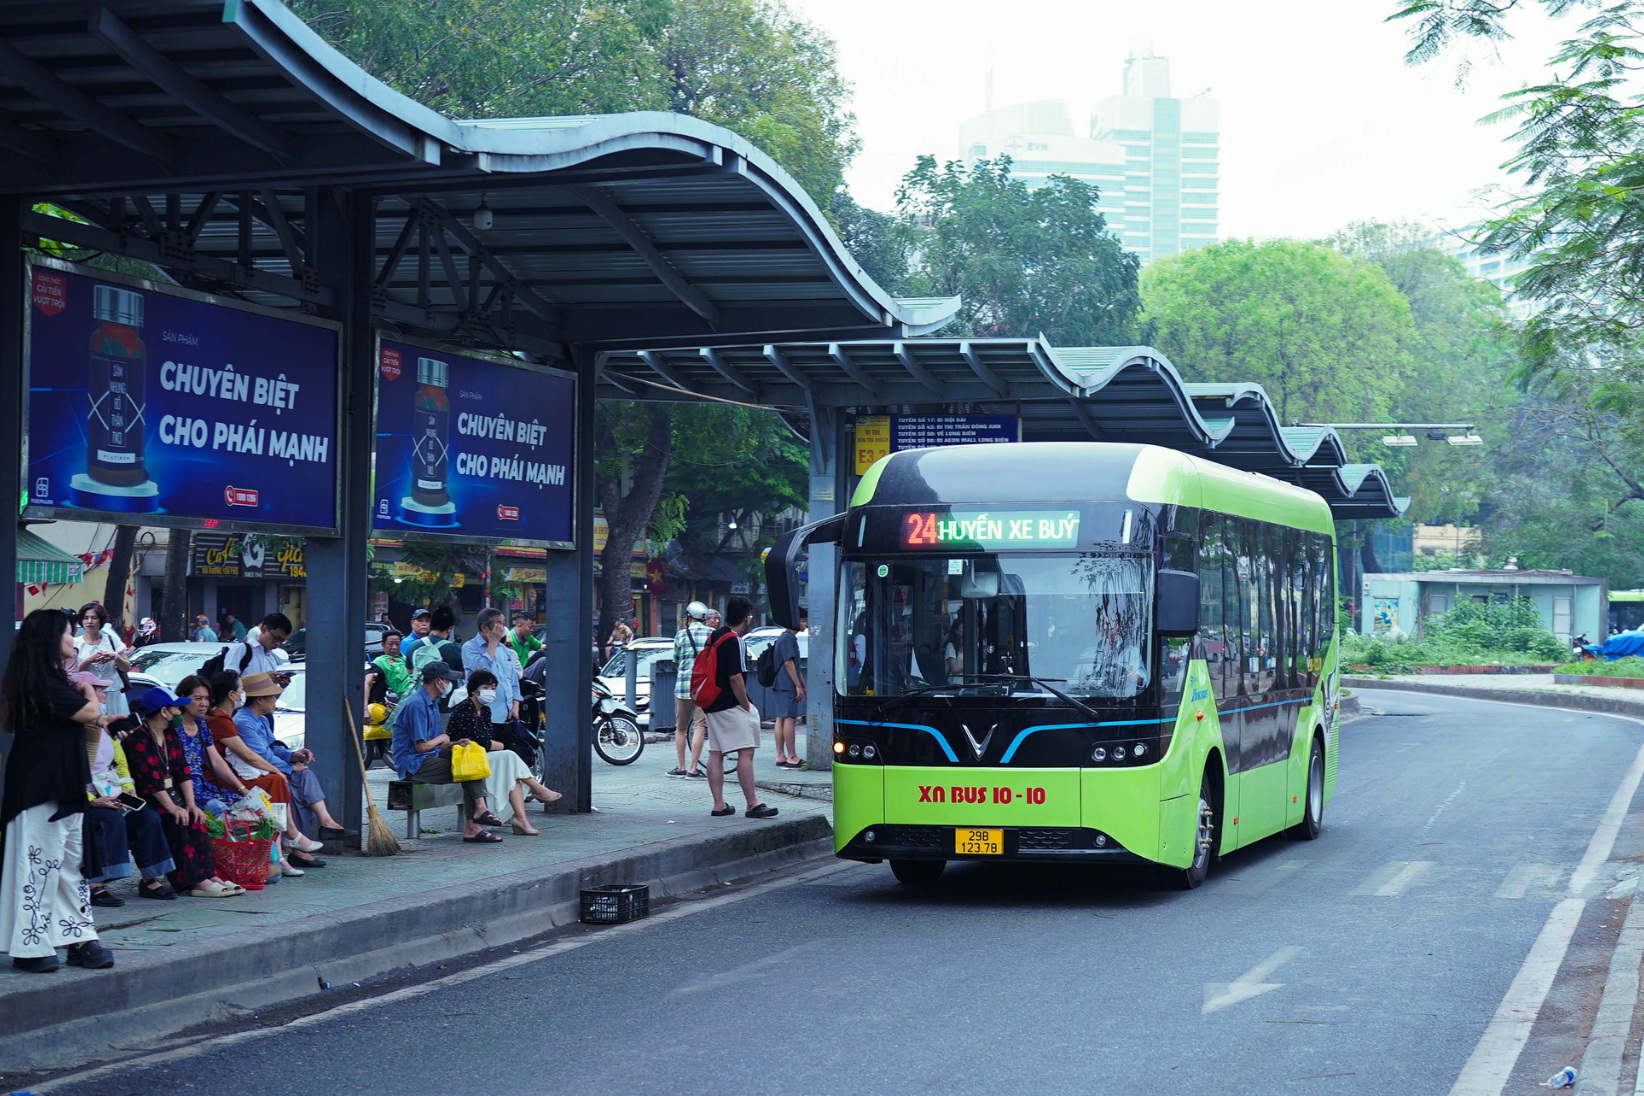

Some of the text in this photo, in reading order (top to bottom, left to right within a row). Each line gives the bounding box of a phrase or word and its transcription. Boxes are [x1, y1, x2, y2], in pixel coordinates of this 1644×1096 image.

[1027, 142, 1049, 151] EVN
[162, 329, 177, 342] SẢN
[160, 361, 299, 415] CHUYÊN BIỆT
[159, 414, 329, 467] CHO PHÁI MẠNH
[457, 412, 547, 450] CHUYÊN BIỆT
[456, 452, 565, 489] CHO PHÁI MẠNH
[908, 513, 937, 544] 24
[937, 512, 1080, 540] HUYẾN XE BUÝ
[951, 786, 987, 803] BUS
[992, 787, 1012, 804] 10
[1026, 787, 1045, 804] 10
[961, 842, 998, 853] 123.78
[968, 830, 989, 841] 29B
